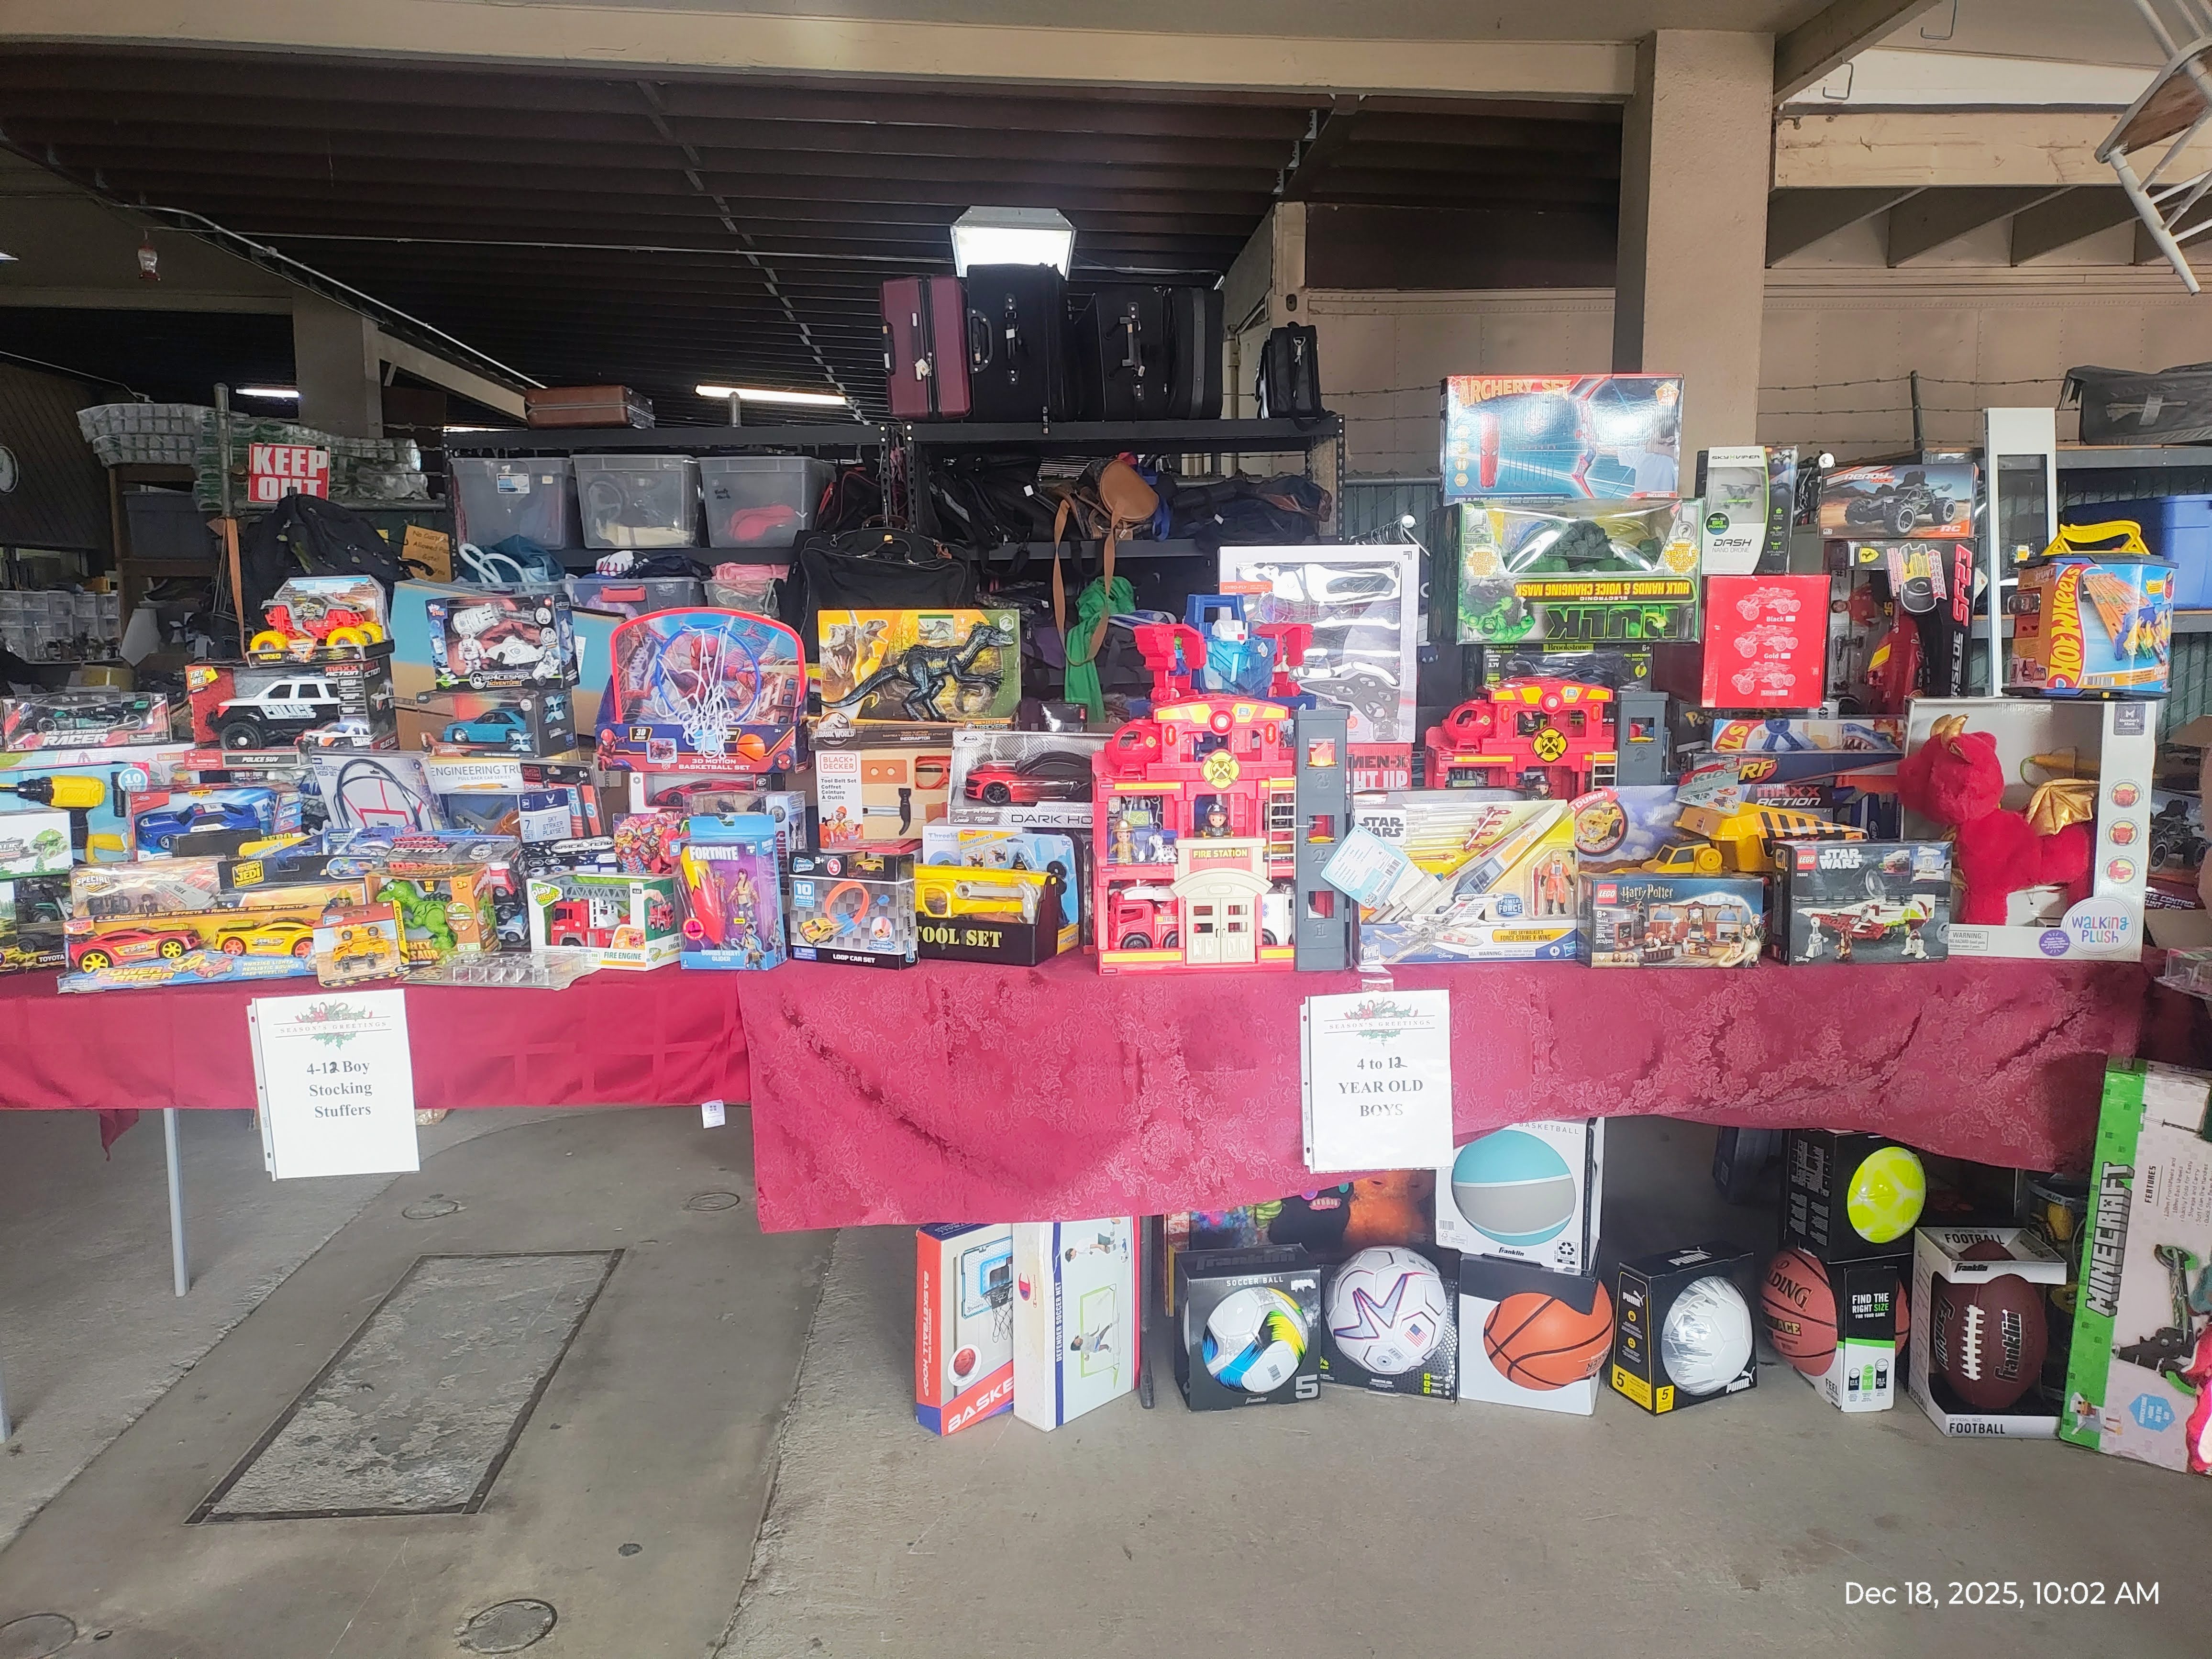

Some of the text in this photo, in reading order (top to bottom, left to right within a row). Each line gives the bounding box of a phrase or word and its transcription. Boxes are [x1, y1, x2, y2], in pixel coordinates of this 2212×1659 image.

[1459, 378, 1571, 407] ARCHERY SET
[253, 449, 328, 476] KEEP
[1844, 472, 1889, 480] READY
[258, 479, 321, 500] OUT
[413, 542, 438, 551] Allowed
[1515, 584, 1544, 597] MASK
[1546, 583, 1593, 596] CHANGING
[1595, 583, 1622, 595] VOICE
[1631, 582, 1664, 595] HANDS
[1667, 582, 1690, 595] HULK
[1546, 605, 1679, 640] HULK
[189, 668, 206, 679] TRY
[190, 676, 207, 686] ME!
[259, 705, 314, 716] POLICE
[42, 734, 109, 746] RACER
[814, 730, 835, 738] JURASSIC
[431, 765, 521, 776] ENGINEERING TRU
[124, 773, 141, 784] 10
[1757, 786, 1819, 797] MAXX
[1757, 797, 1821, 806] ACTION
[1358, 817, 1404, 827] STAR
[542, 827, 565, 835] PLAYSET
[961, 833, 993, 846] imaginext
[689, 845, 739, 861] FORTNITE
[1213, 849, 1248, 858] STATION
[1798, 849, 1862, 863] LEGO STAR
[233, 863, 261, 874] YOUNG
[1819, 858, 1862, 870] WARS
[75, 875, 110, 885] SPECIAL
[236, 869, 261, 881] JEDI
[796, 883, 812, 896] 10
[1620, 886, 1647, 902] Harry
[1648, 885, 1673, 899] Potter
[538, 891, 561, 902] RIGHT
[2160, 896, 2196, 908] CONTROL
[1498, 904, 1523, 913] FORCE
[394, 906, 404, 941] Construction
[915, 926, 1002, 948] TOOL SET
[38, 954, 65, 962] TOYOTA
[280, 1021, 387, 1033] SEASON'S GREETINGS
[343, 1061, 370, 1075] Boy
[1357, 1058, 1365, 1070] 4
[1370, 1059, 1382, 1070] to
[309, 1082, 373, 1097] Stocking
[1338, 1079, 1424, 1094] YEAR OLD
[314, 1105, 372, 1118] Stuffers
[1360, 1104, 1404, 1117] BOYS
[1518, 1122, 1580, 1135] BASKETBALL
[2145, 1165, 2156, 1204] FEATURES
[1944, 1233, 2005, 1244] FOOTBALL
[2086, 1161, 2135, 1317] MINECRAFT
[1498, 1247, 1525, 1257] Franklin
[1954, 1263, 1988, 1272] Franklin
[1226, 1278, 1259, 1286] SOCCER
[1623, 1292, 1642, 1307] PUMA
[1852, 1293, 1889, 1305] FIND THE
[1852, 1303, 1889, 1314] RIGHT SIZE
[1995, 1309, 2022, 1383] Franklin
[1615, 1371, 1626, 1387] 5
[1295, 1374, 1318, 1399] 5
[1725, 1381, 1750, 1394] PUMA
[1825, 1378, 1838, 1395] FEEL
[1660, 1388, 1669, 1400] 5
[948, 1376, 1014, 1433] BASKE
[1245, 1396, 1268, 1405] Franklin
[1949, 1423, 2006, 1435] FOOTBALL
